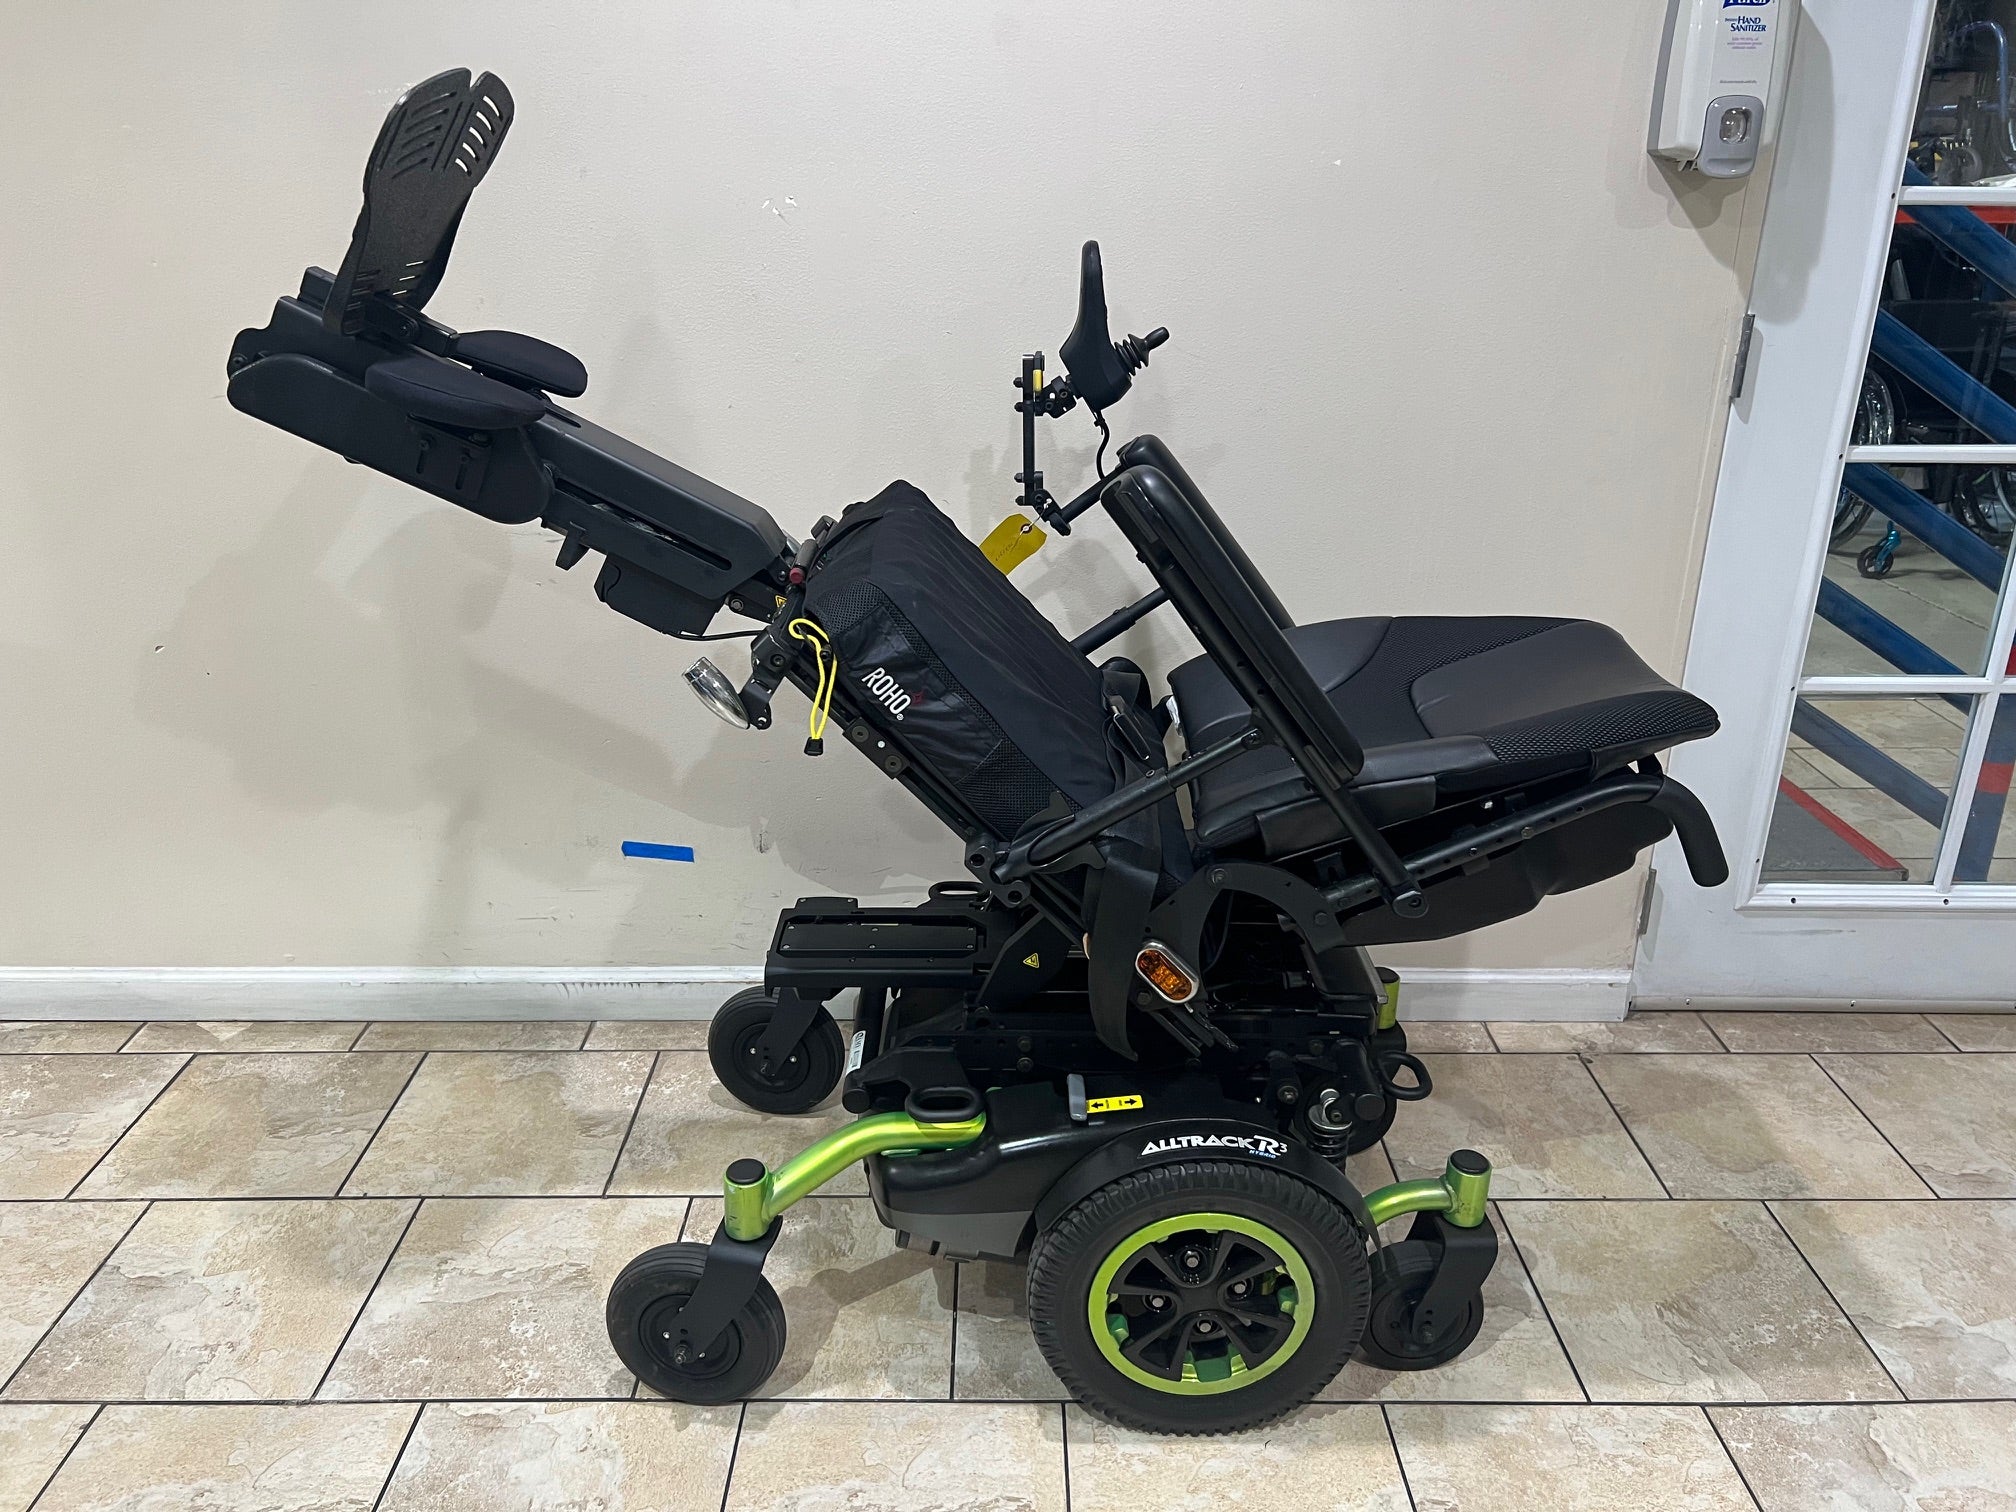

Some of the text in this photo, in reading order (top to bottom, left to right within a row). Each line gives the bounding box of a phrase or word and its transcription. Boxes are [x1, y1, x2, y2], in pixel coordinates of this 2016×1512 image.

[1738, 16, 1761, 24] HAND
[1730, 23, 1766, 31] SANITIZER
[1141, 1134, 1255, 1156] ALLTRACK
